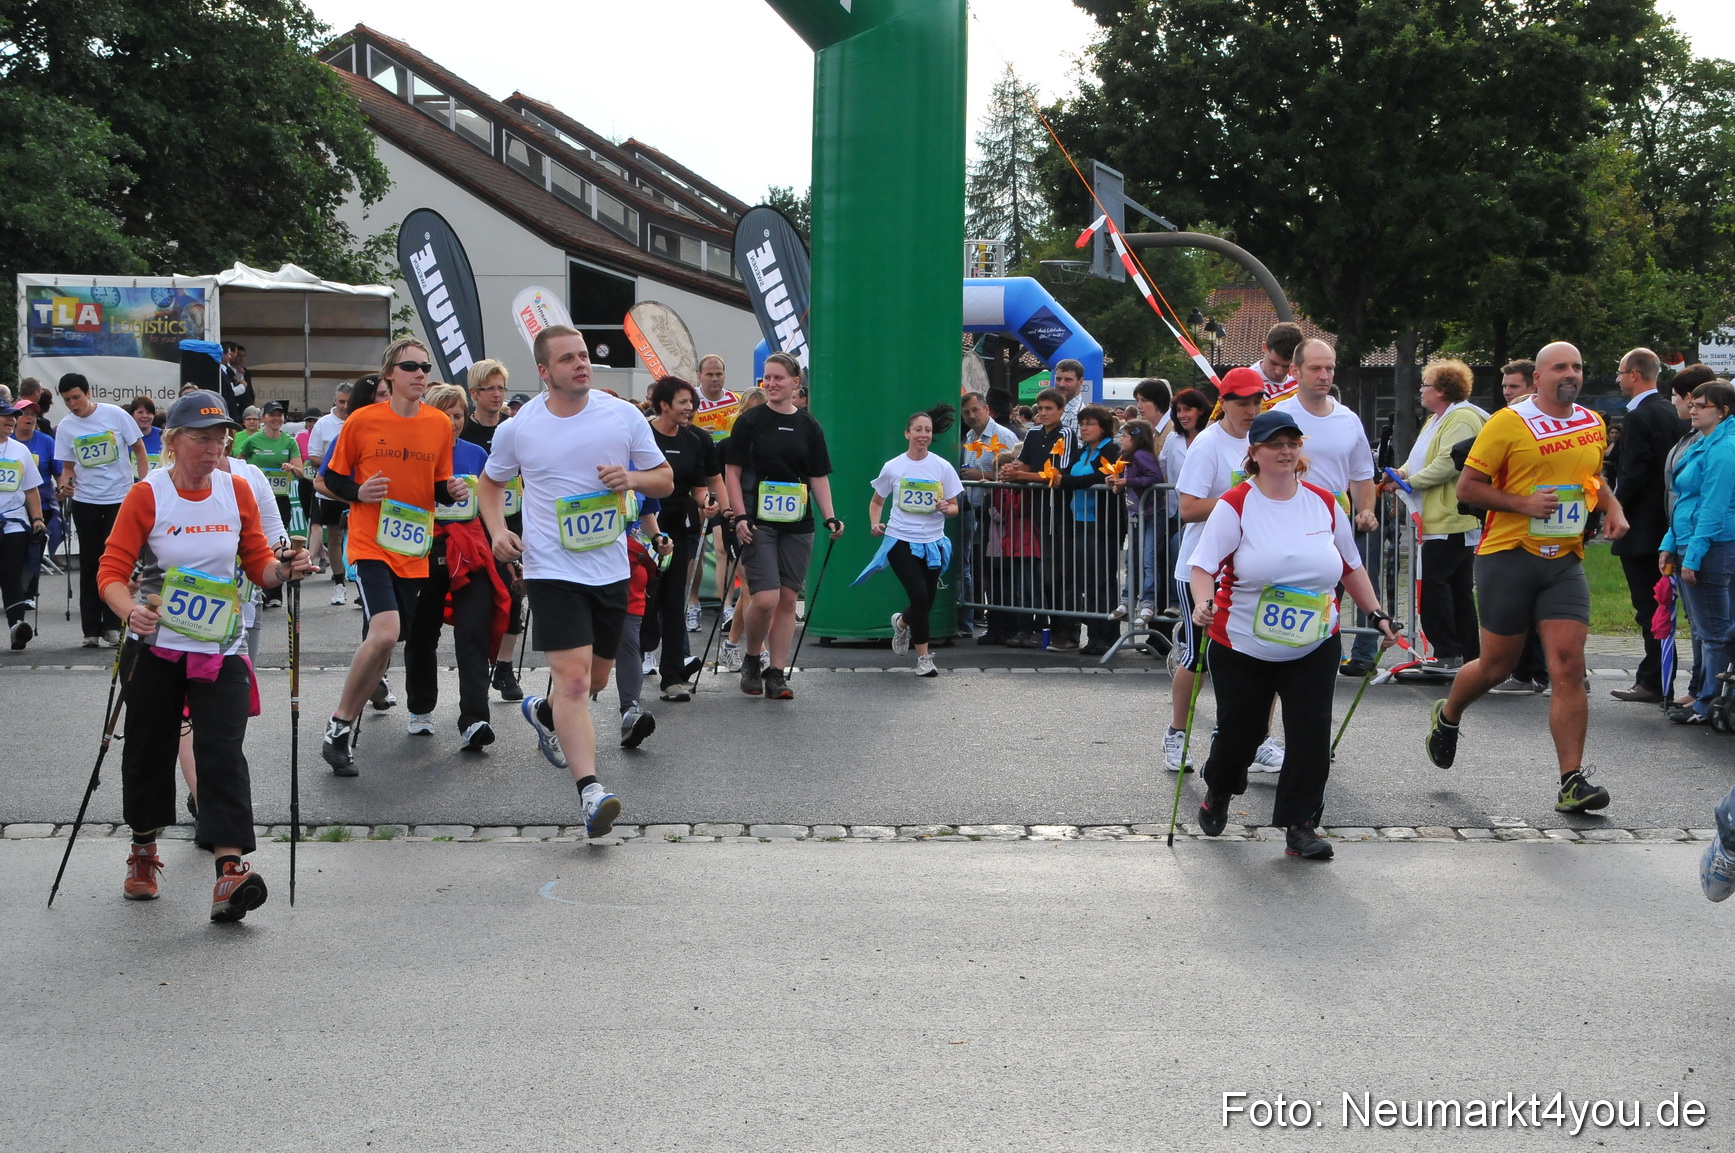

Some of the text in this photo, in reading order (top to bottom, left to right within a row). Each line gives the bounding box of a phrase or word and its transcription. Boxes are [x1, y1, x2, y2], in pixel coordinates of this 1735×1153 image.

[34, 304, 99, 325] TLA
[110, 315, 187, 338] Logistics
[698, 413, 717, 423] MAX
[81, 442, 108, 460] 237
[1538, 431, 1604, 456] MAX BÖGL
[375, 448, 435, 462] EURO POLES
[763, 495, 796, 512] 516
[903, 490, 934, 506] 233
[185, 524, 232, 534] KLEBL
[382, 517, 425, 544] 1356
[563, 509, 617, 537] 1027
[575, 536, 594, 544] Stefan
[167, 589, 227, 624] 507
[170, 615, 203, 630] Charlotte
[1263, 603, 1315, 633] 867
[1268, 627, 1295, 637] Michaela
